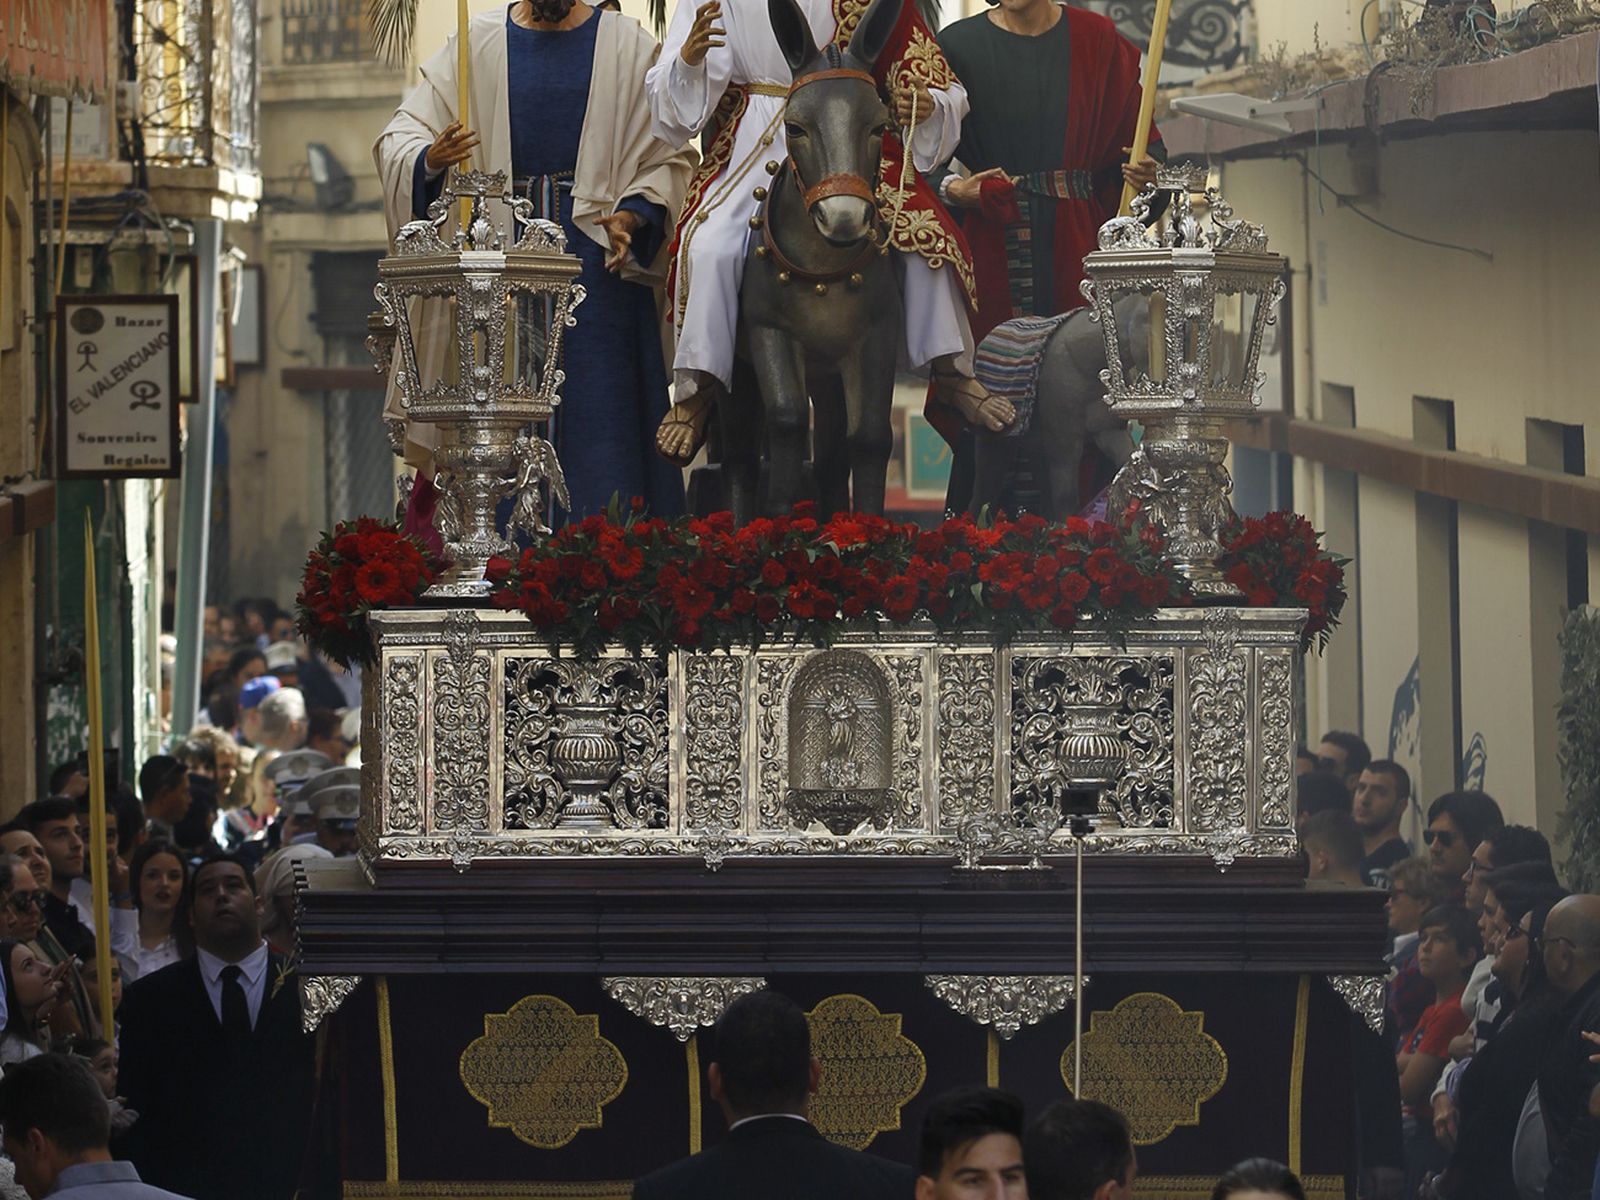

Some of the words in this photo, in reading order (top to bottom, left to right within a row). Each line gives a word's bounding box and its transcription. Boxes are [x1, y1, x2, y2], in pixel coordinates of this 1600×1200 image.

[115, 316, 164, 327] Bazar
[68, 397, 91, 415] EL
[87, 331, 170, 399] VALENCIANO
[76, 432, 157, 444] Souvenirs
[104, 454, 167, 467] Regalos
